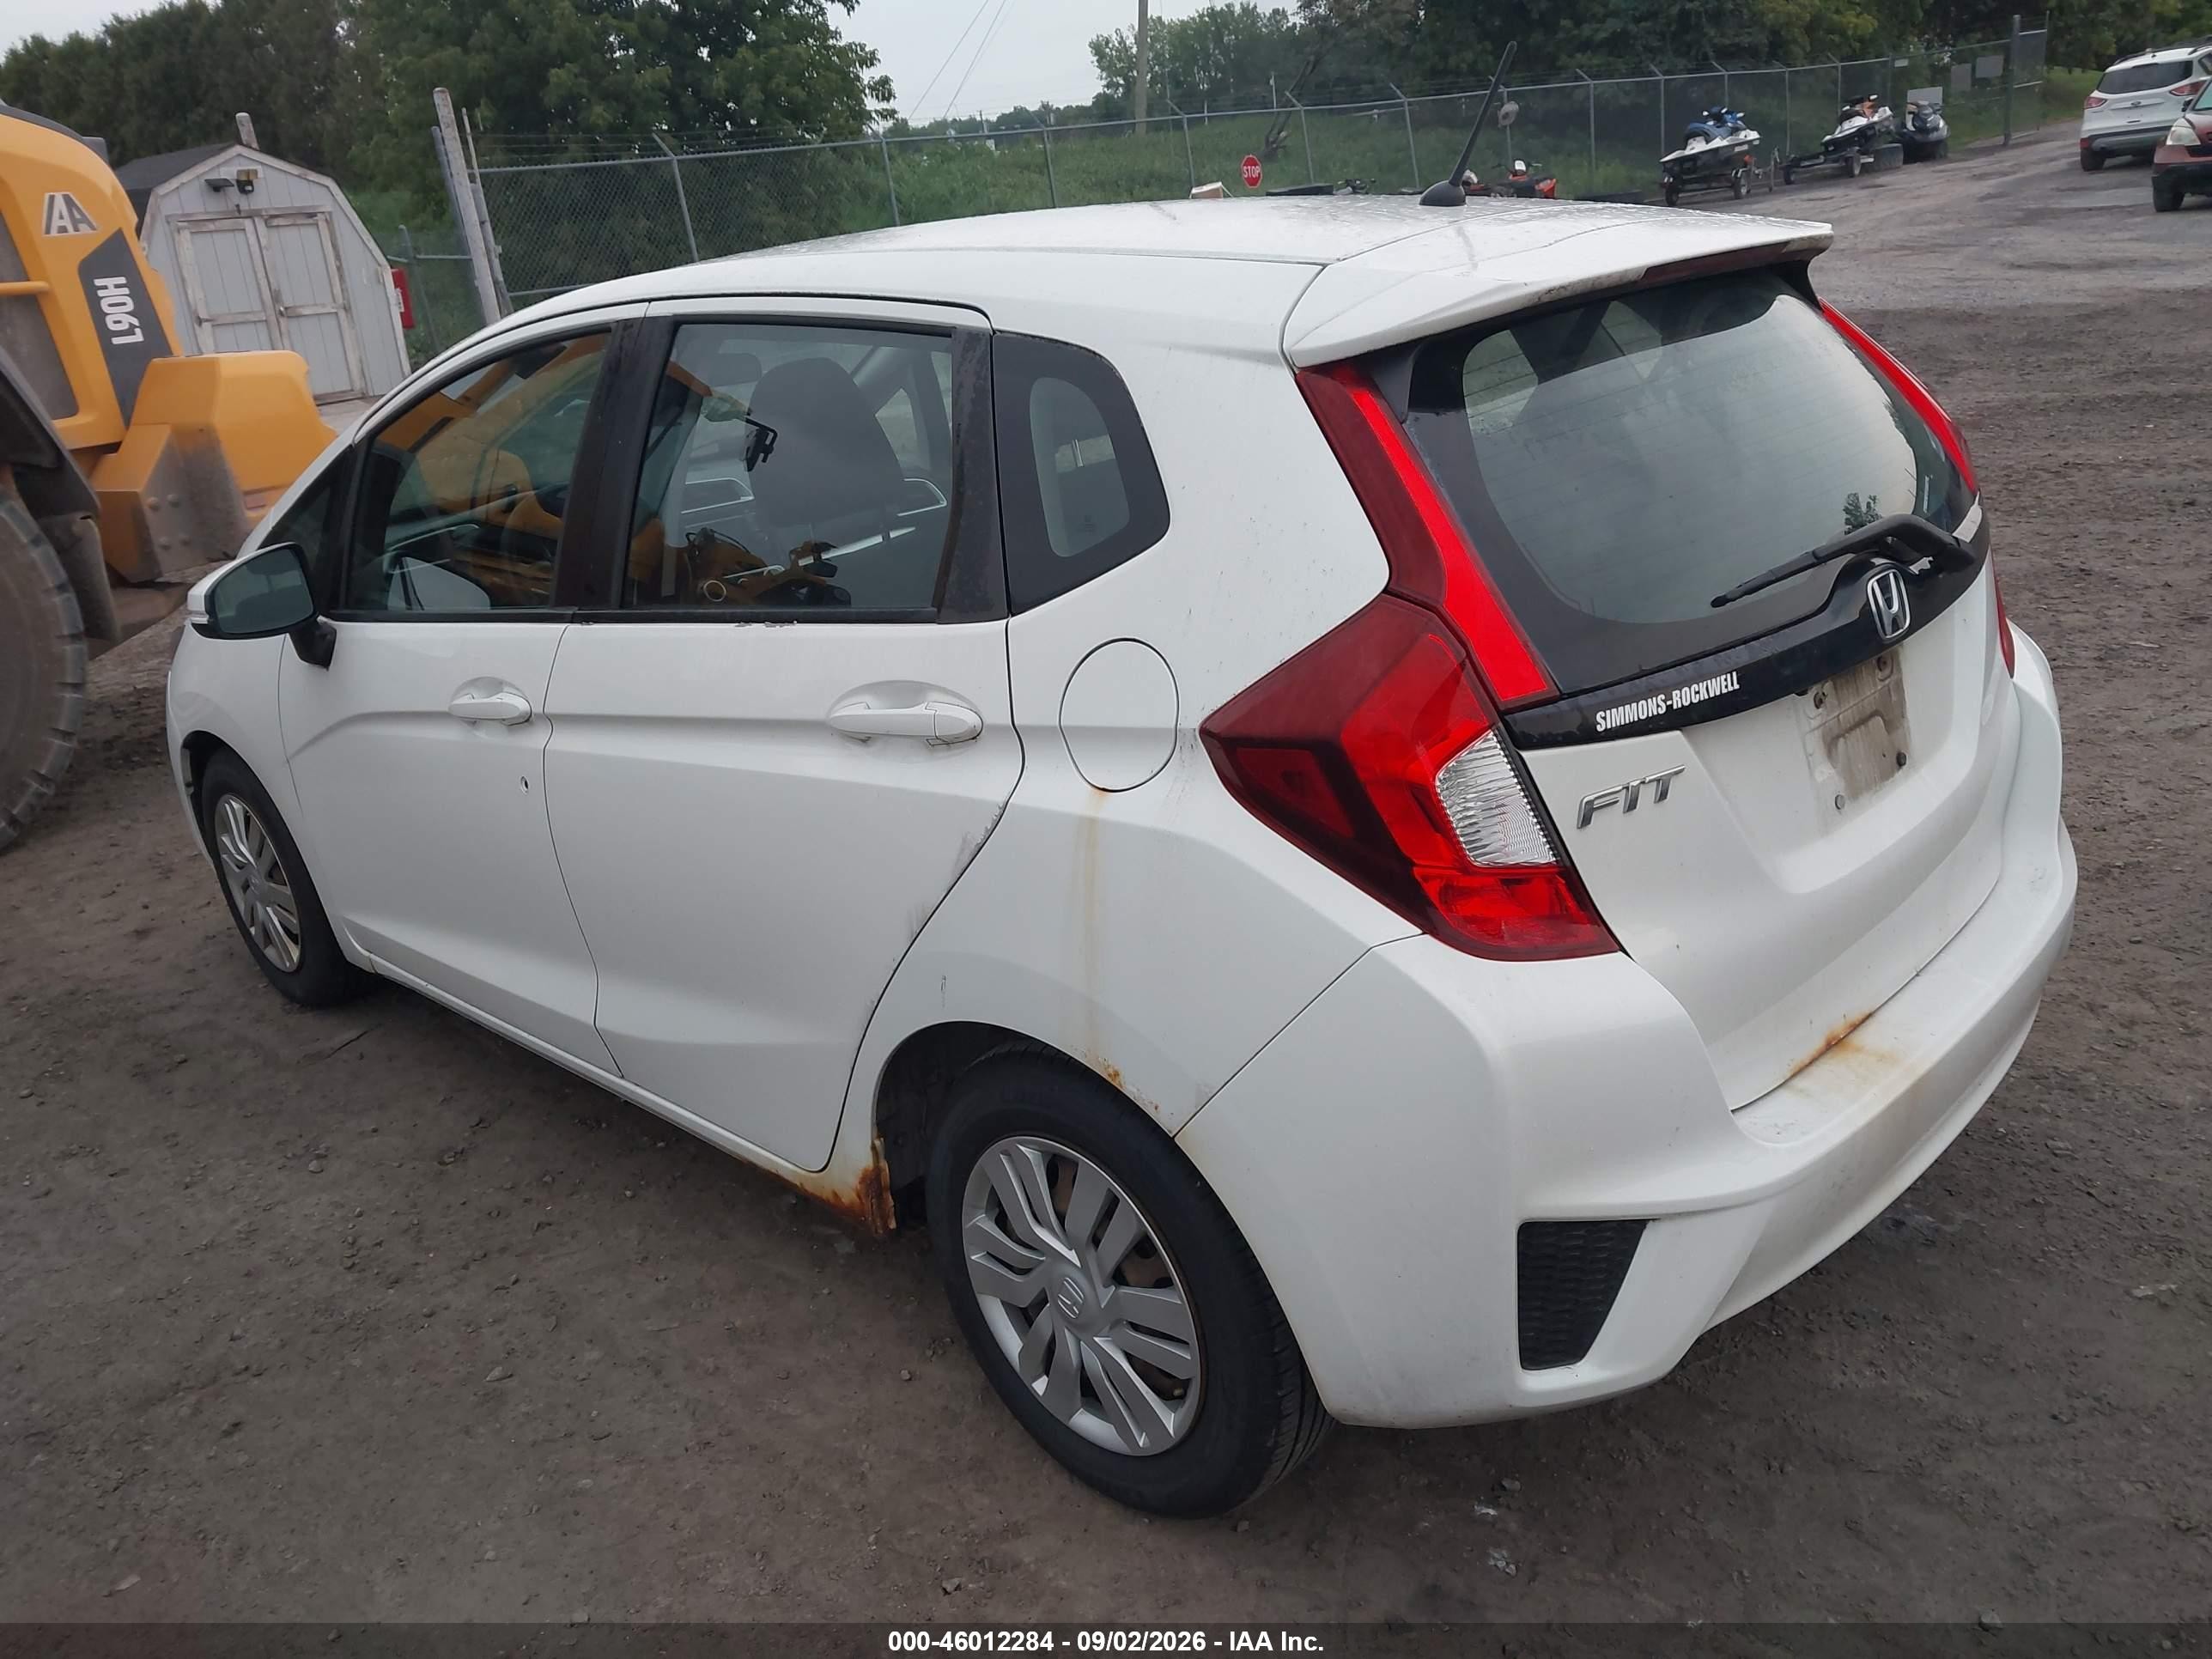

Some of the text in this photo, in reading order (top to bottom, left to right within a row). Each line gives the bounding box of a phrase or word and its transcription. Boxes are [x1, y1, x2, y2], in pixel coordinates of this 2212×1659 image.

[1243, 165, 1261, 179] STOP
[93, 276, 144, 345] L90H
[1595, 671, 1740, 732] SIMMONS-ROCKWELL
[1577, 763, 1686, 830] FIT
